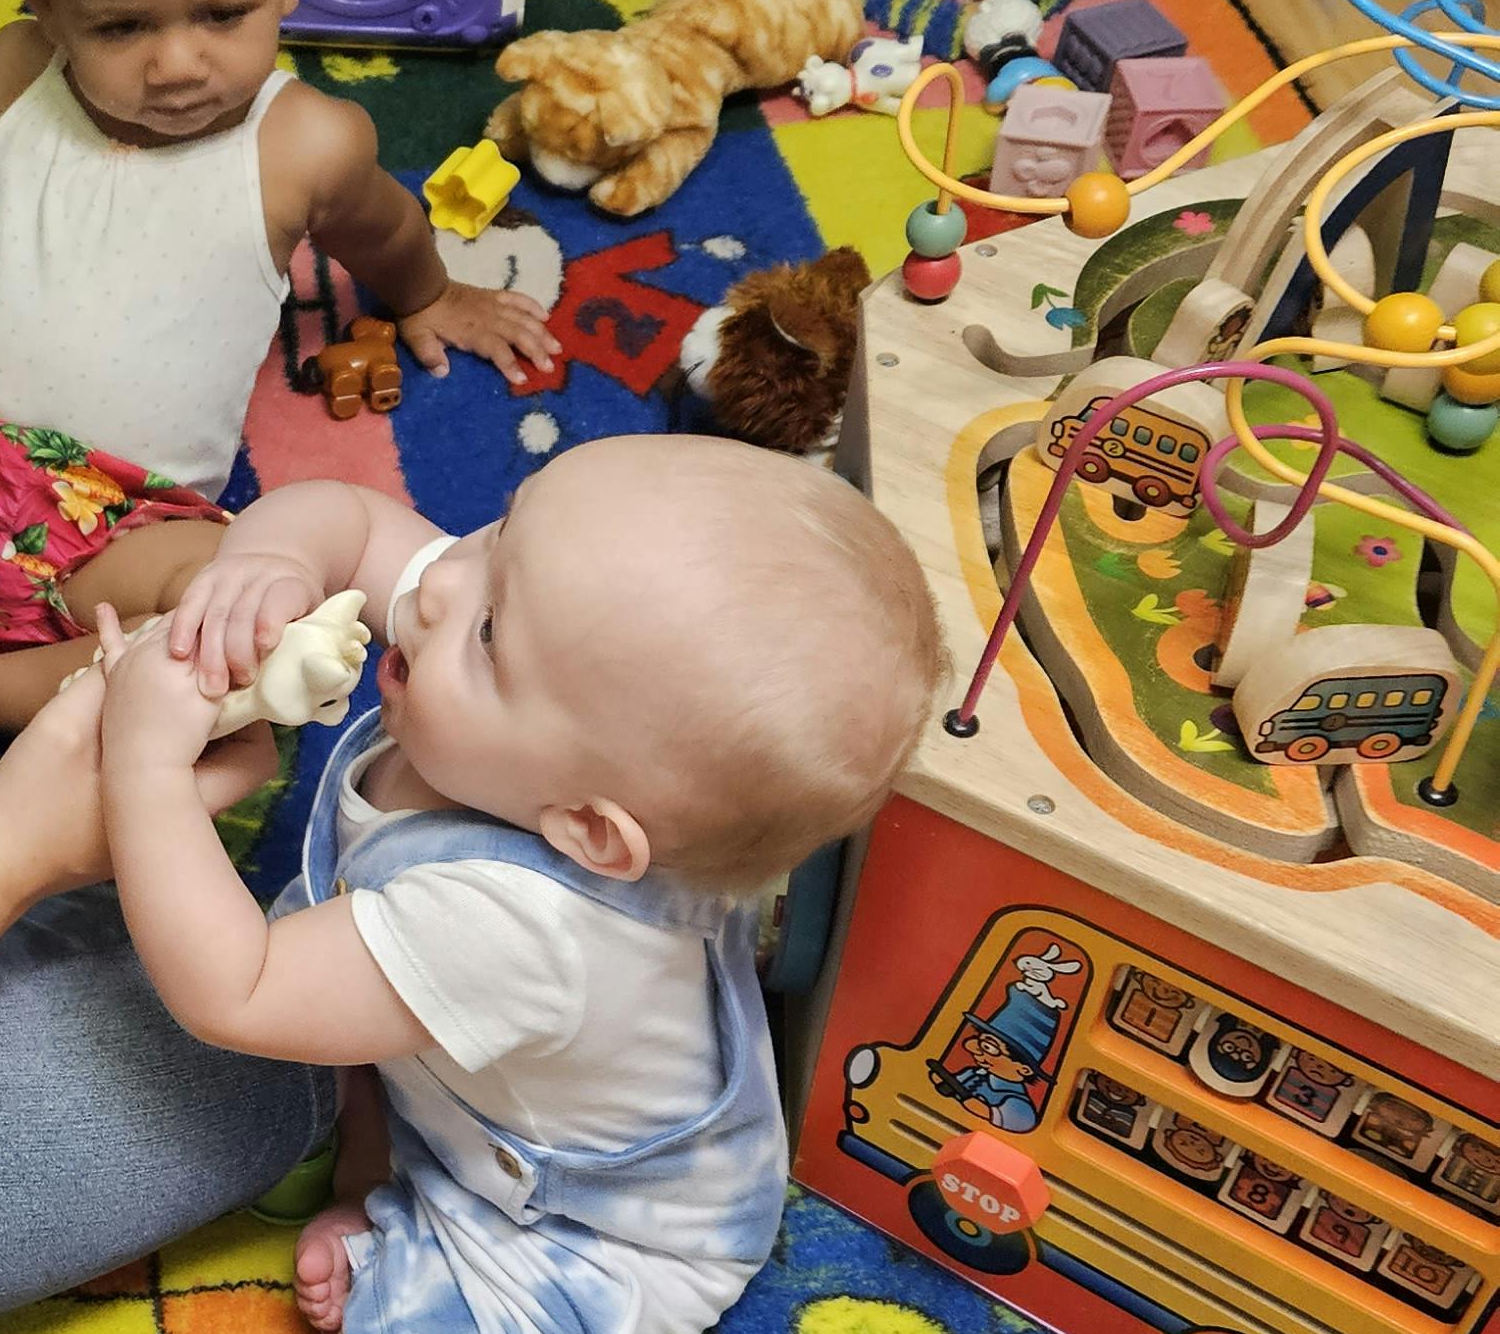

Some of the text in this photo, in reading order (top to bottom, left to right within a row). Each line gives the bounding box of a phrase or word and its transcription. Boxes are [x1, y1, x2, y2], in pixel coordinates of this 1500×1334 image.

[575, 295, 666, 359] 2
[1107, 441, 1120, 454] 2
[1144, 1007, 1157, 1028] 1
[1293, 1084, 1319, 1108] 3
[941, 1173, 1021, 1223] STOP
[1247, 1182, 1269, 1205] 8
[1331, 1223, 1350, 1245] 9
[1399, 1254, 1440, 1285] 10
